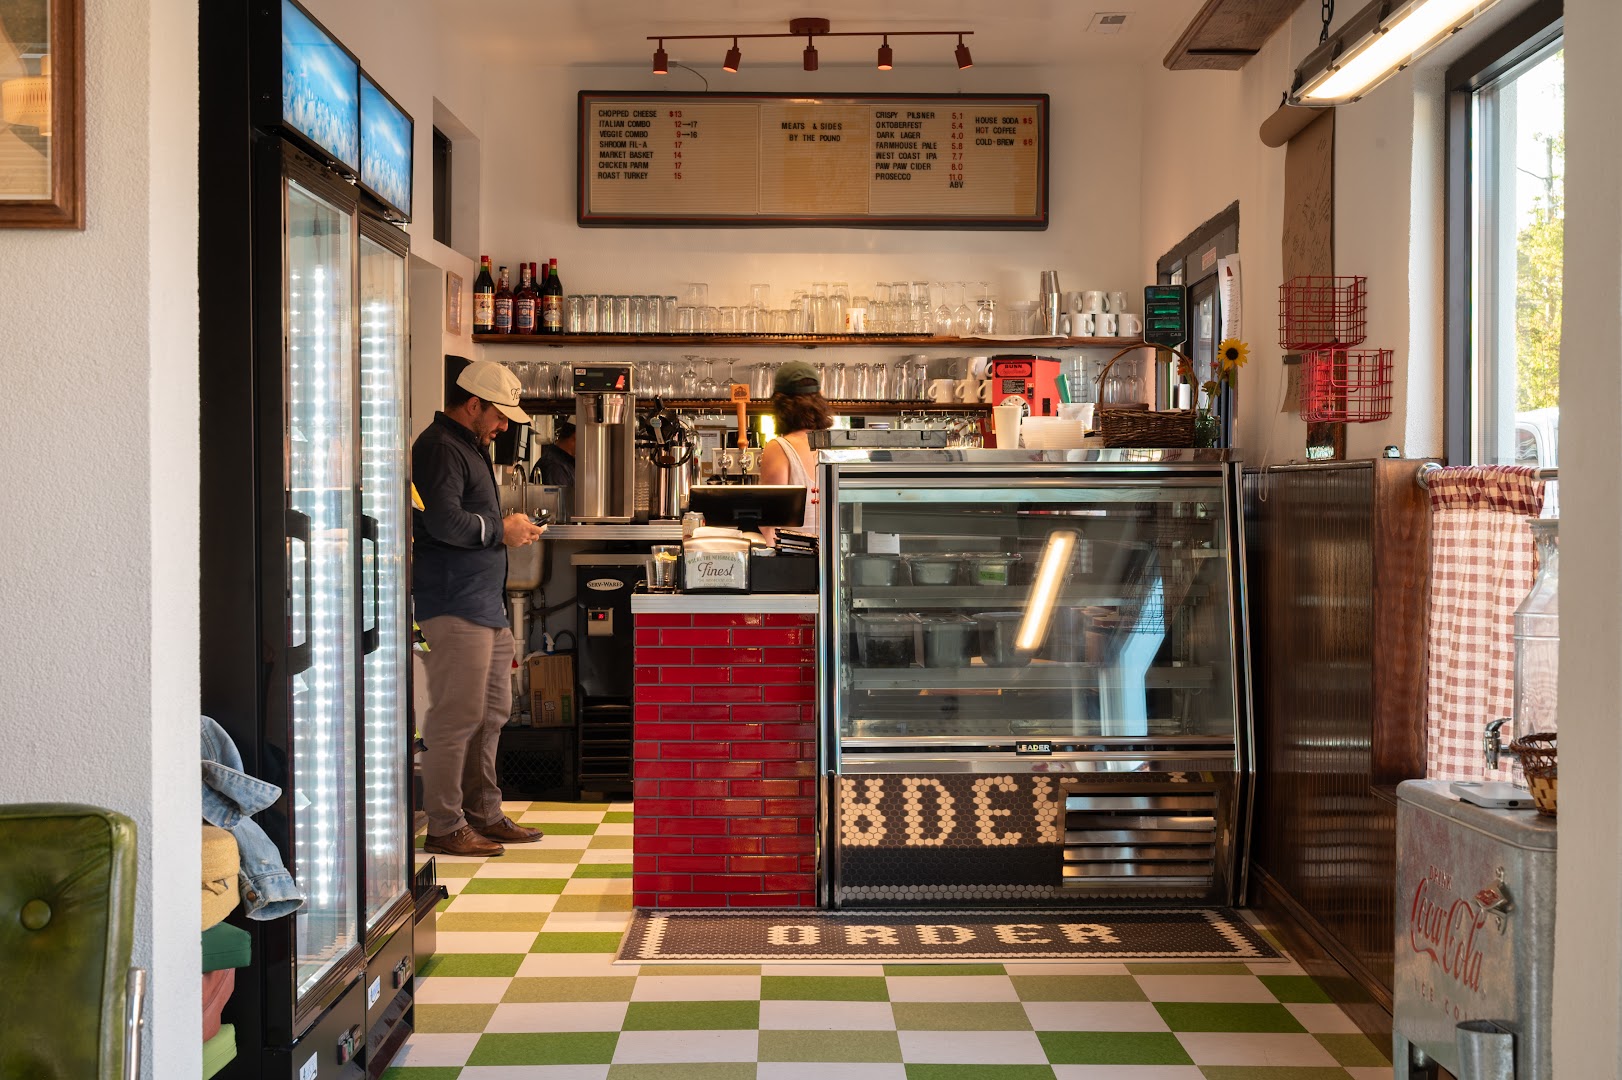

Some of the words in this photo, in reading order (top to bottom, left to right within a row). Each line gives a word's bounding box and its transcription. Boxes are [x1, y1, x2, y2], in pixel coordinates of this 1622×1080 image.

[698, 562, 734, 578] Finest
[1016, 744, 1050, 752] LEADER
[1429, 865, 1452, 891] DRINK
[768, 923, 1122, 946] ORDER
[1410, 878, 1486, 992] Coca-Cola
[1414, 978, 1434, 1002] ICE
